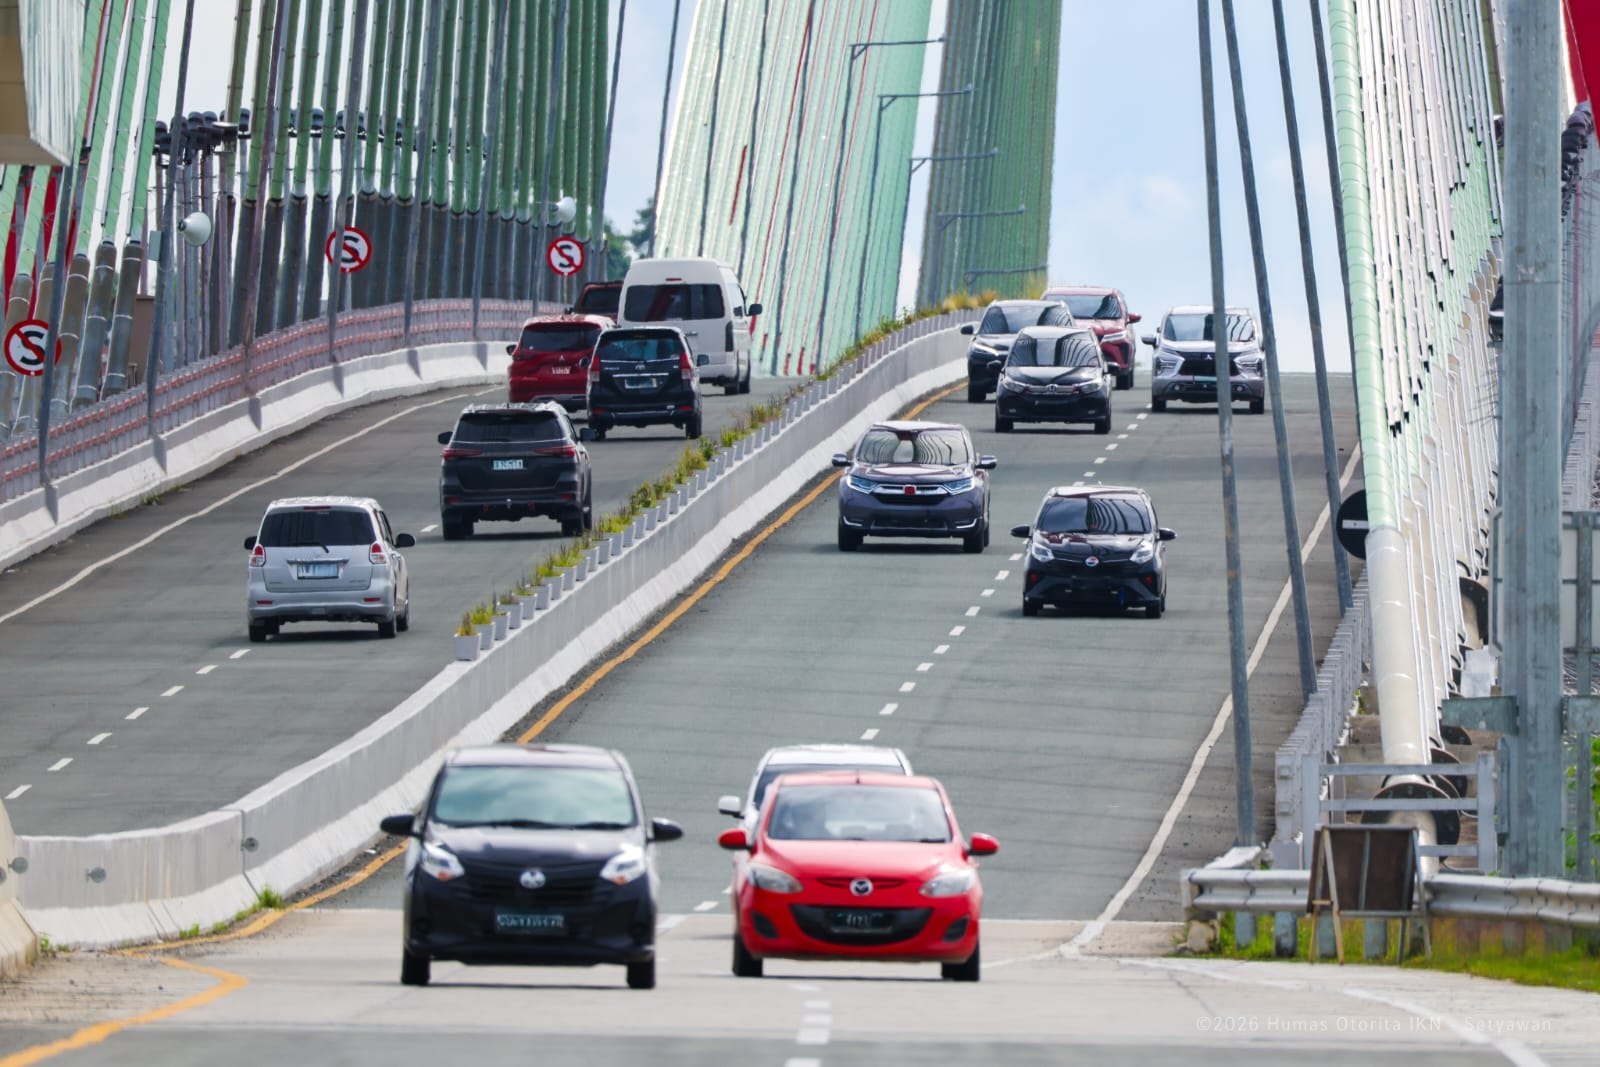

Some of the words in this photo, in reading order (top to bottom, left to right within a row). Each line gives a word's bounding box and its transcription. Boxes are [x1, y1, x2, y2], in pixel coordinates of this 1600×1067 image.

[340, 235, 360, 264] S
[558, 244, 574, 268] S
[20, 330, 46, 366] S
